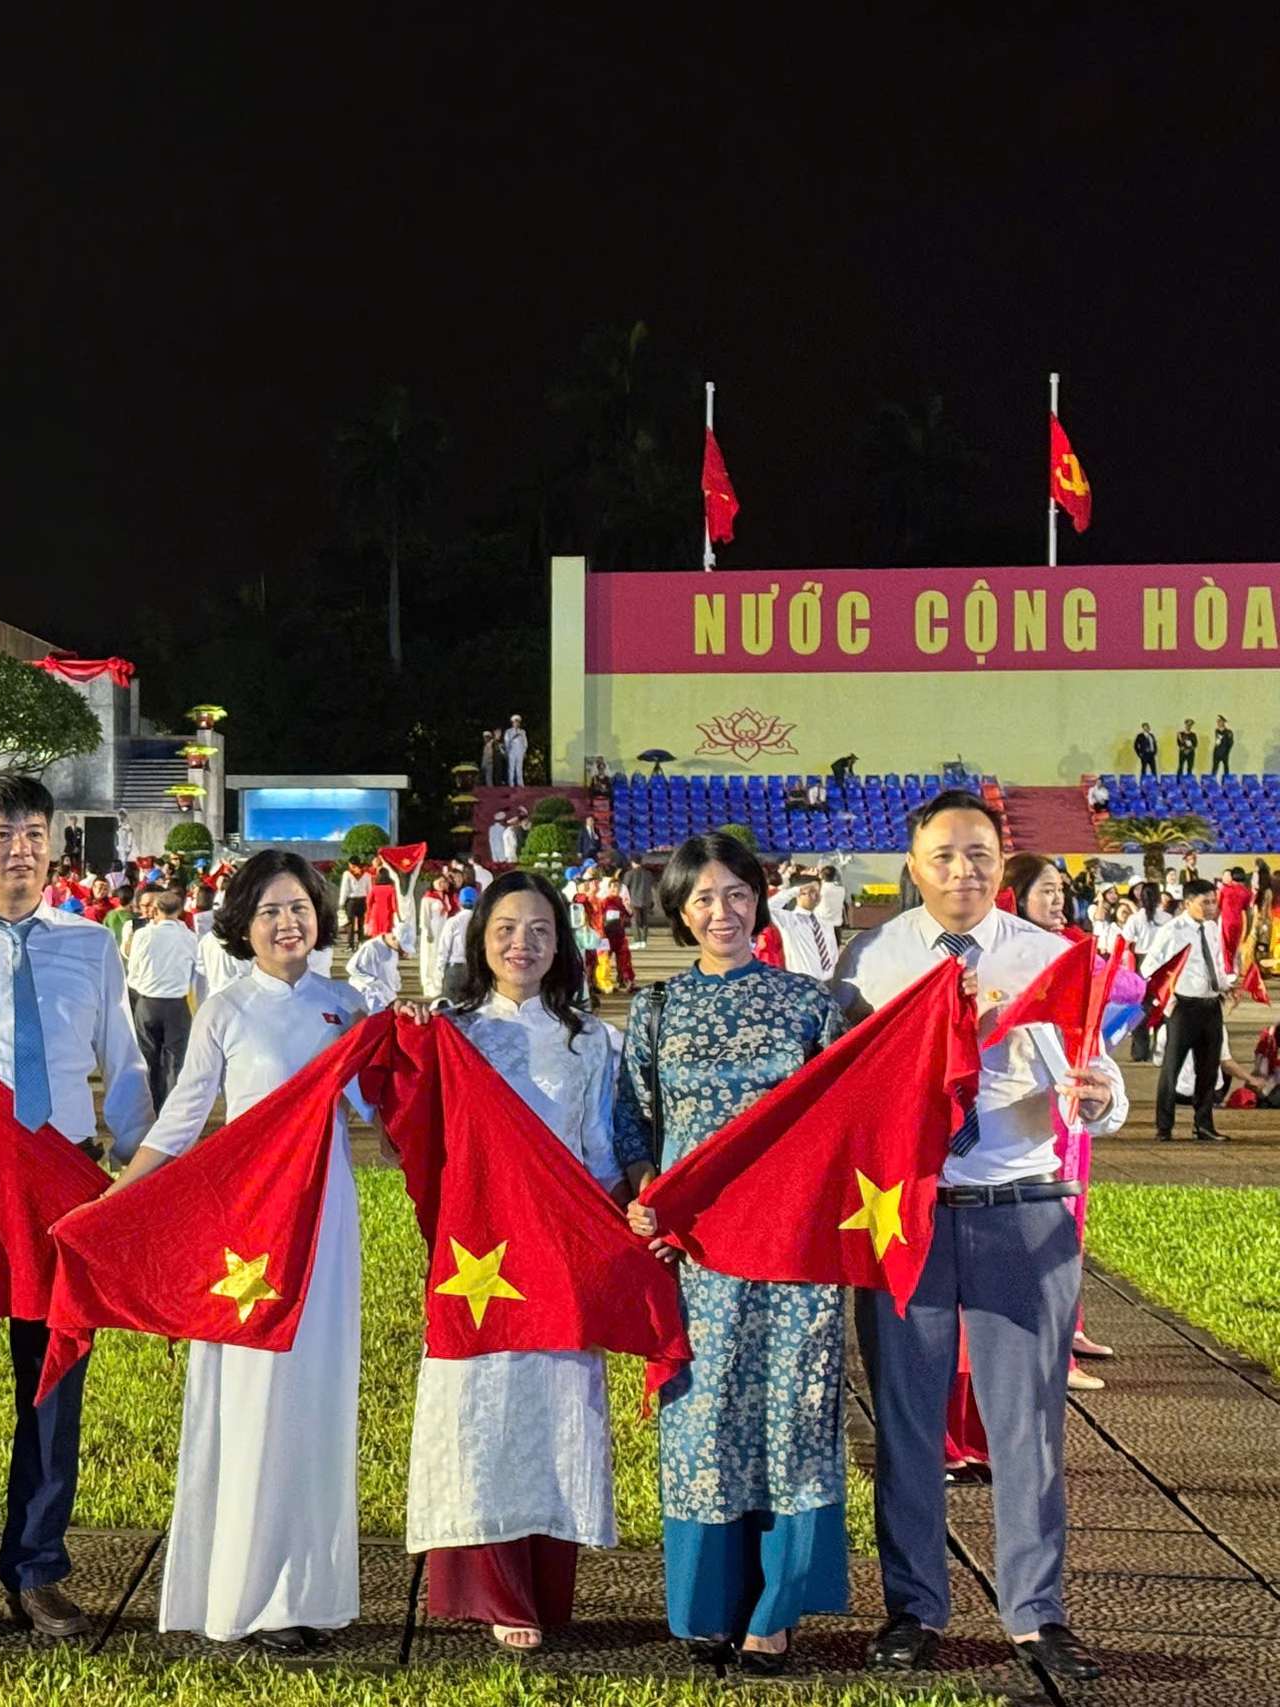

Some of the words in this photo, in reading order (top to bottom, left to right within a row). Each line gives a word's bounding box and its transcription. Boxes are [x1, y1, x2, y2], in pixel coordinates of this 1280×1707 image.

[694, 581, 871, 655] NƯỚC
[915, 579, 1097, 664] CỘNG
[1143, 576, 1279, 651] HÒA
